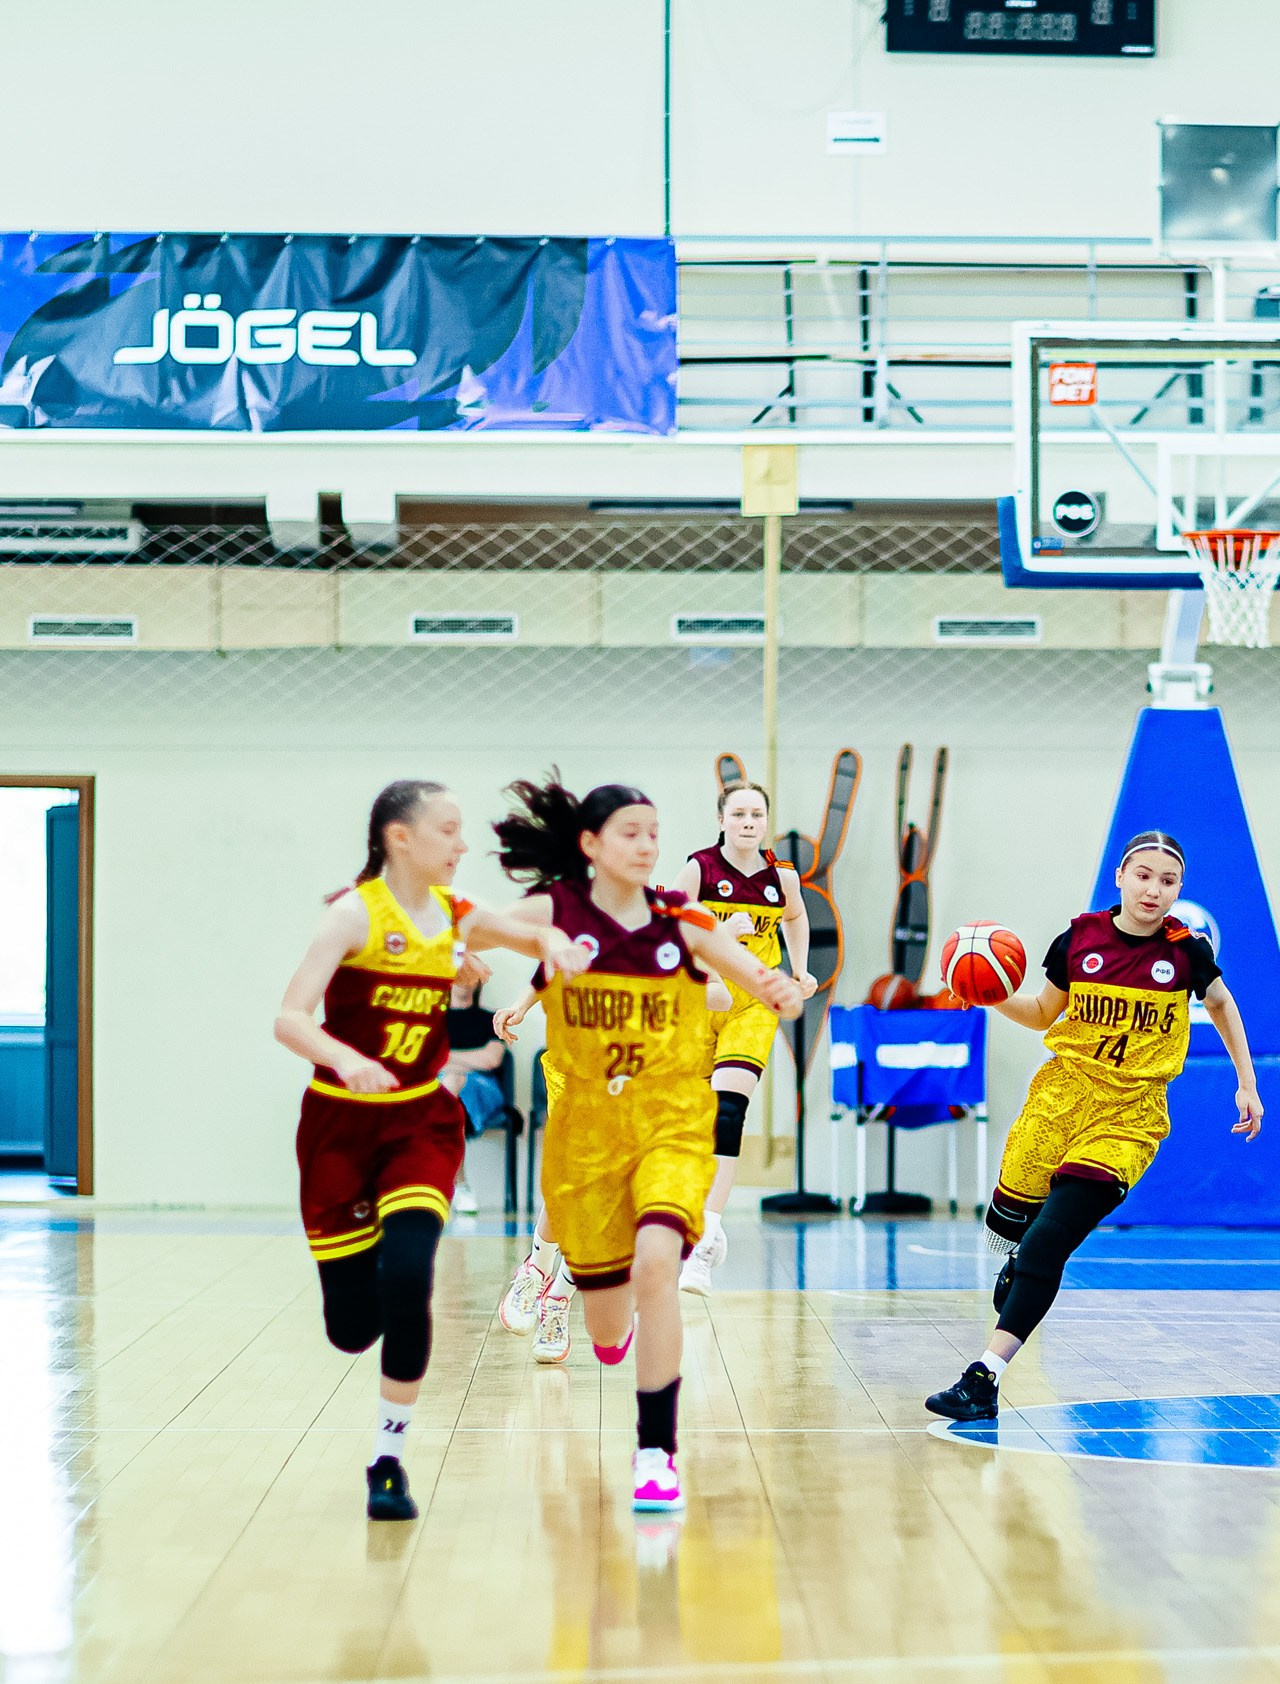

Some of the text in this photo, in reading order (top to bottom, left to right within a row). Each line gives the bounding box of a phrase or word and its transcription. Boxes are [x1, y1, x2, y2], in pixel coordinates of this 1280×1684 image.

[113, 293, 418, 367] JÖGEL
[562, 986, 634, 1032] СШОР
[1069, 993, 1128, 1028] СШОР
[1159, 1001, 1178, 1034] 5
[605, 1042, 645, 1078] 25
